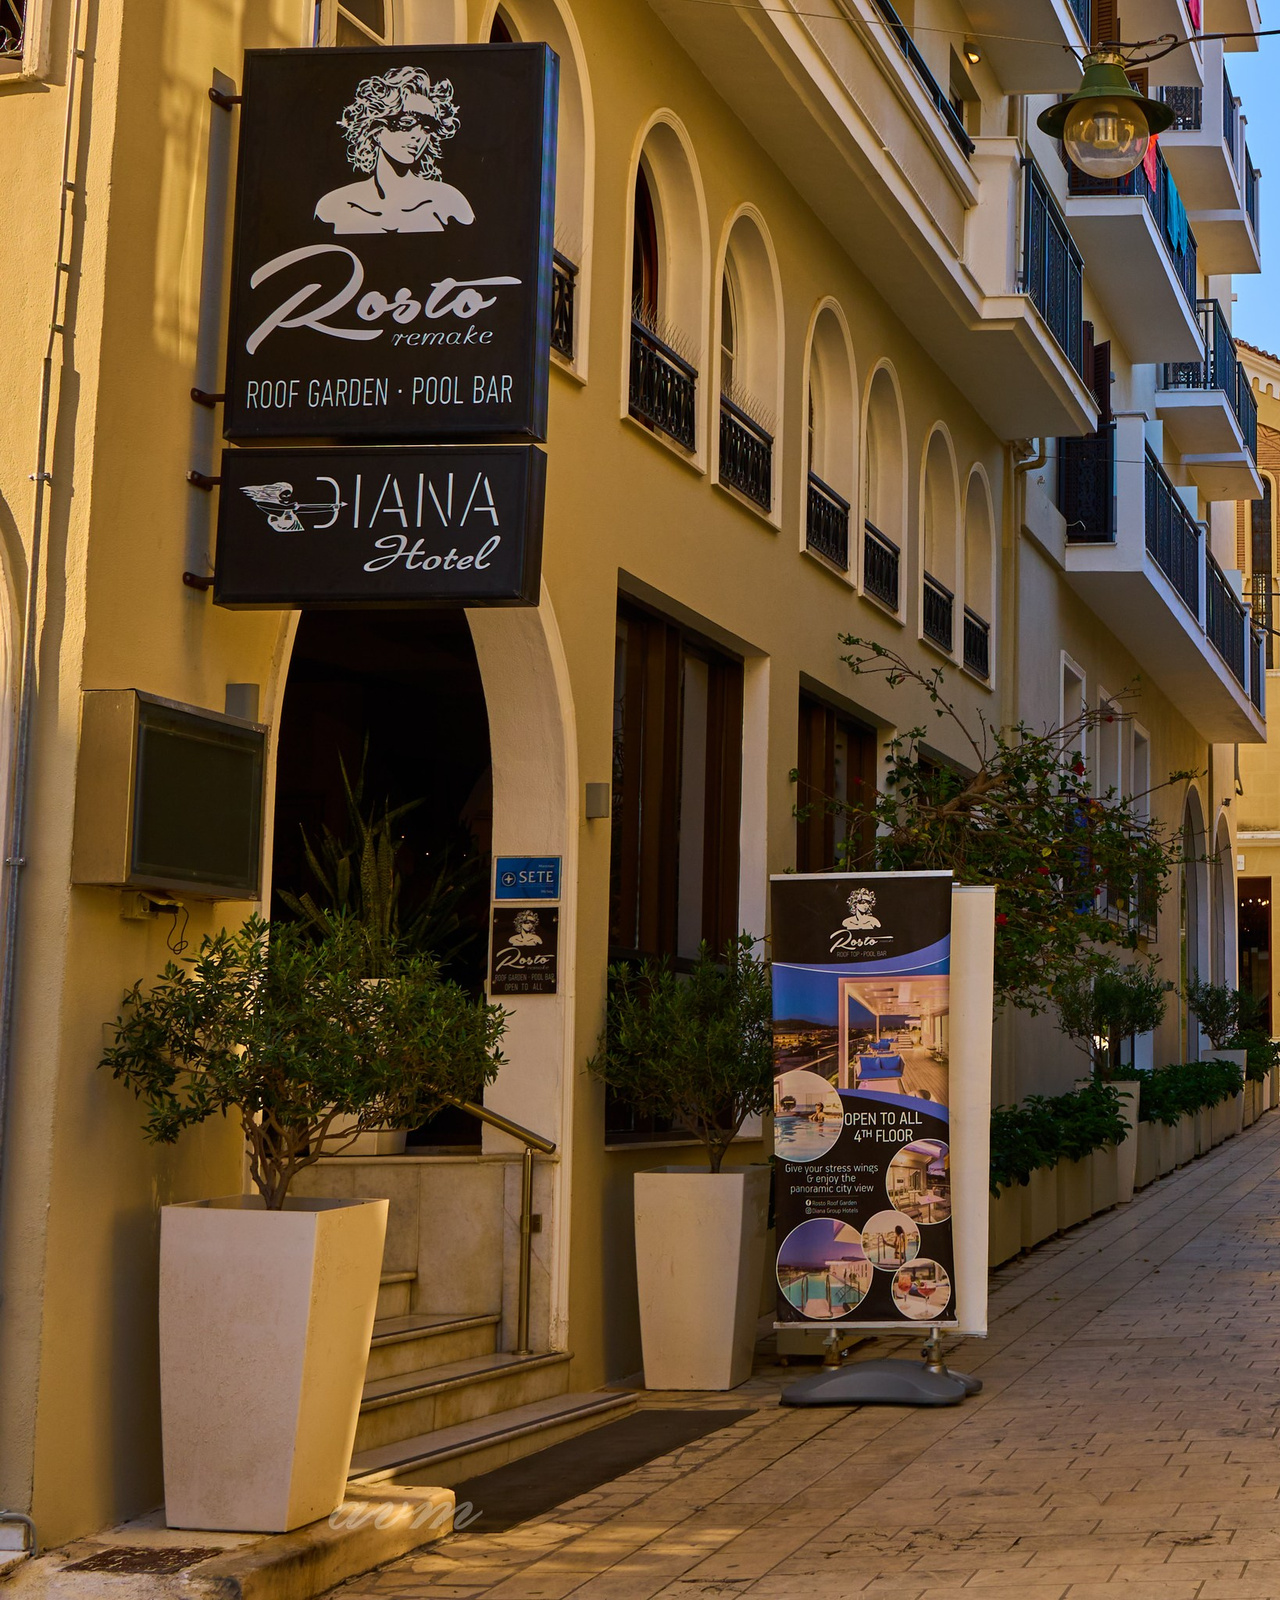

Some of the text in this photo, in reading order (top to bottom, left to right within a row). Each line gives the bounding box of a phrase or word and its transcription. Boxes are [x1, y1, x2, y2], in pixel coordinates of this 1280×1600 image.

[245, 243, 522, 355] Rosto
[391, 324, 494, 347] remake
[246, 374, 513, 409] ROOF GARDEN POOL BAR
[313, 472, 500, 529] DIANA
[363, 534, 501, 572] Hotel
[519, 871, 554, 883] SETE
[830, 929, 893, 953] Rosto
[495, 947, 555, 972] Rosto
[504, 983, 543, 991] OPEN TO ALL
[844, 1111, 923, 1126] OPEN TO ALL
[854, 1128, 913, 1143] 4TH FLOOR
[785, 1163, 879, 1174] Give your stress wings
[790, 1184, 874, 1195] panoramic city view
[815, 1174, 840, 1186] enjoy
[841, 1174, 857, 1182] the
